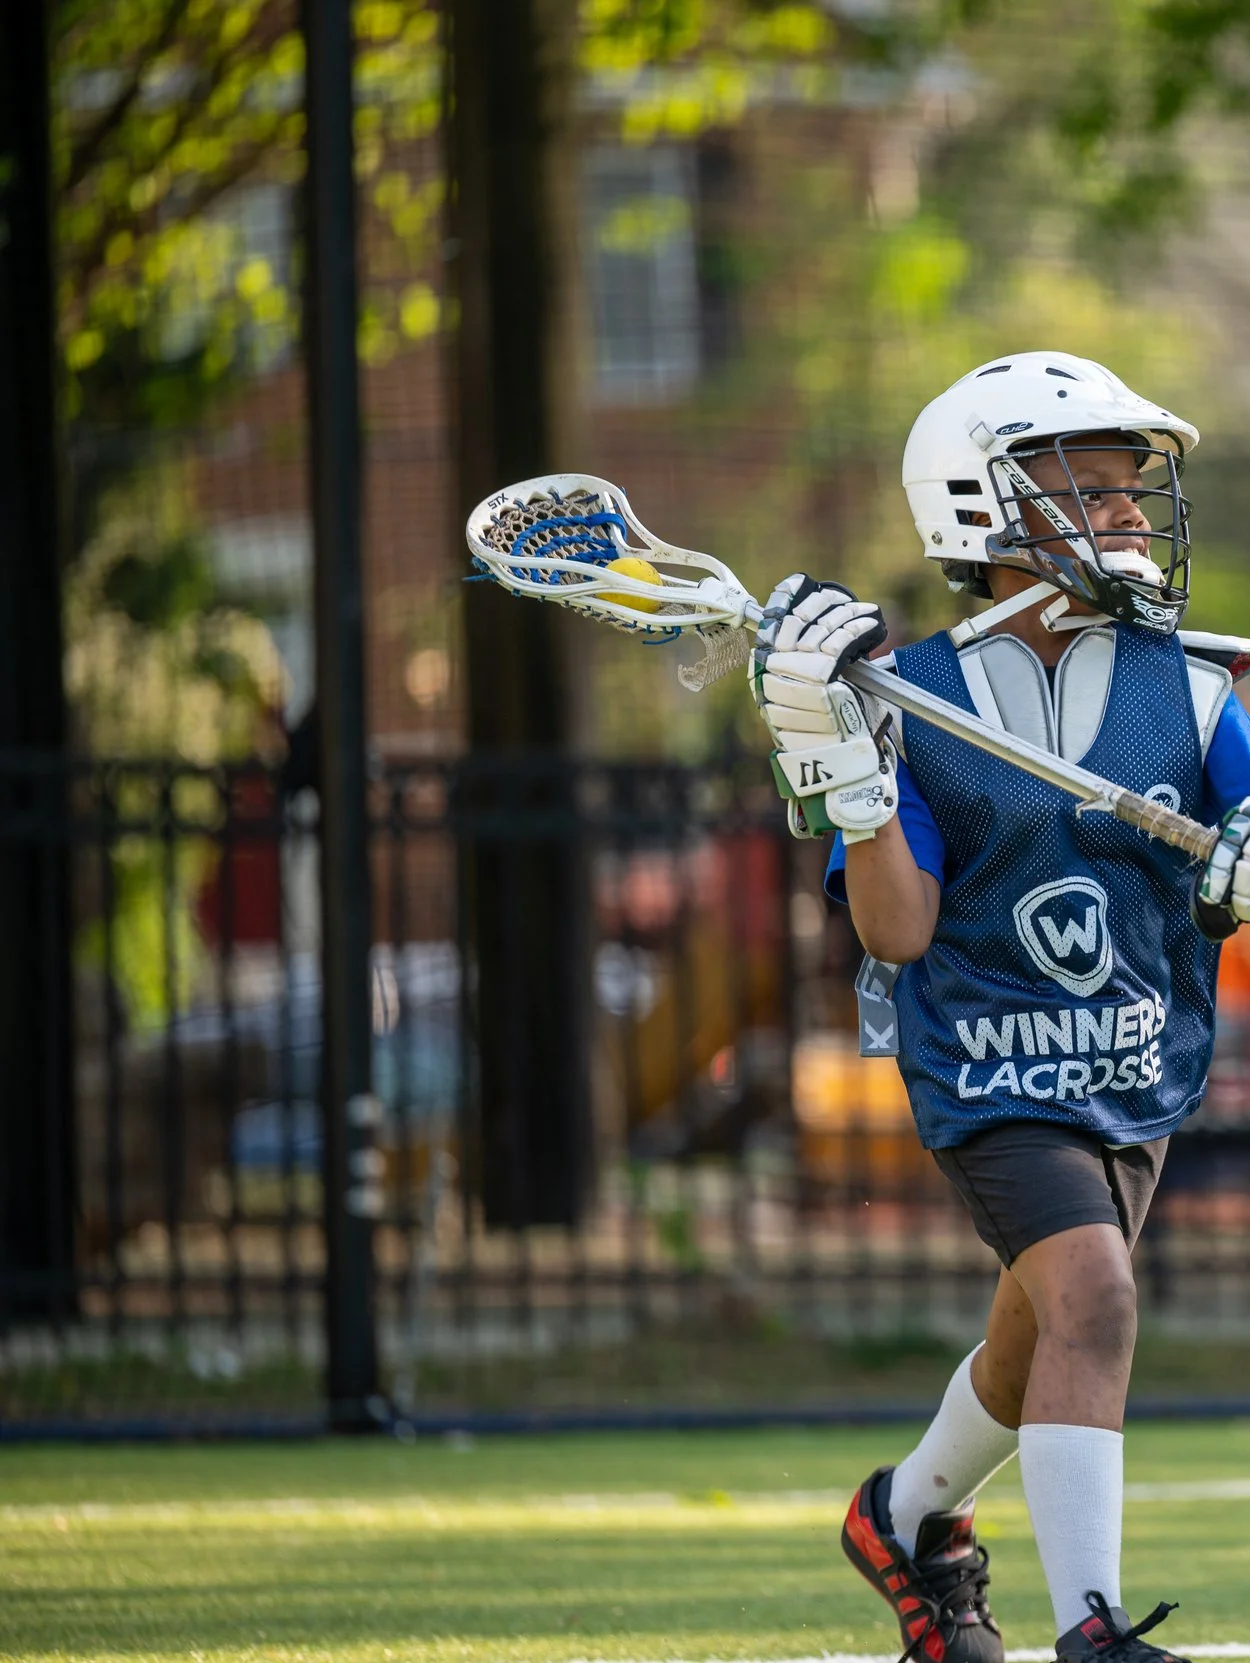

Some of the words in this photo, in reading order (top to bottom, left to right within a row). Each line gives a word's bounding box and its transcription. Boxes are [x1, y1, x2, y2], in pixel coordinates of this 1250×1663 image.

[487, 492, 509, 510] STX
[1038, 904, 1097, 958] W
[955, 991, 1166, 1060] WINNERS
[957, 1040, 1163, 1100] LACROSSE
